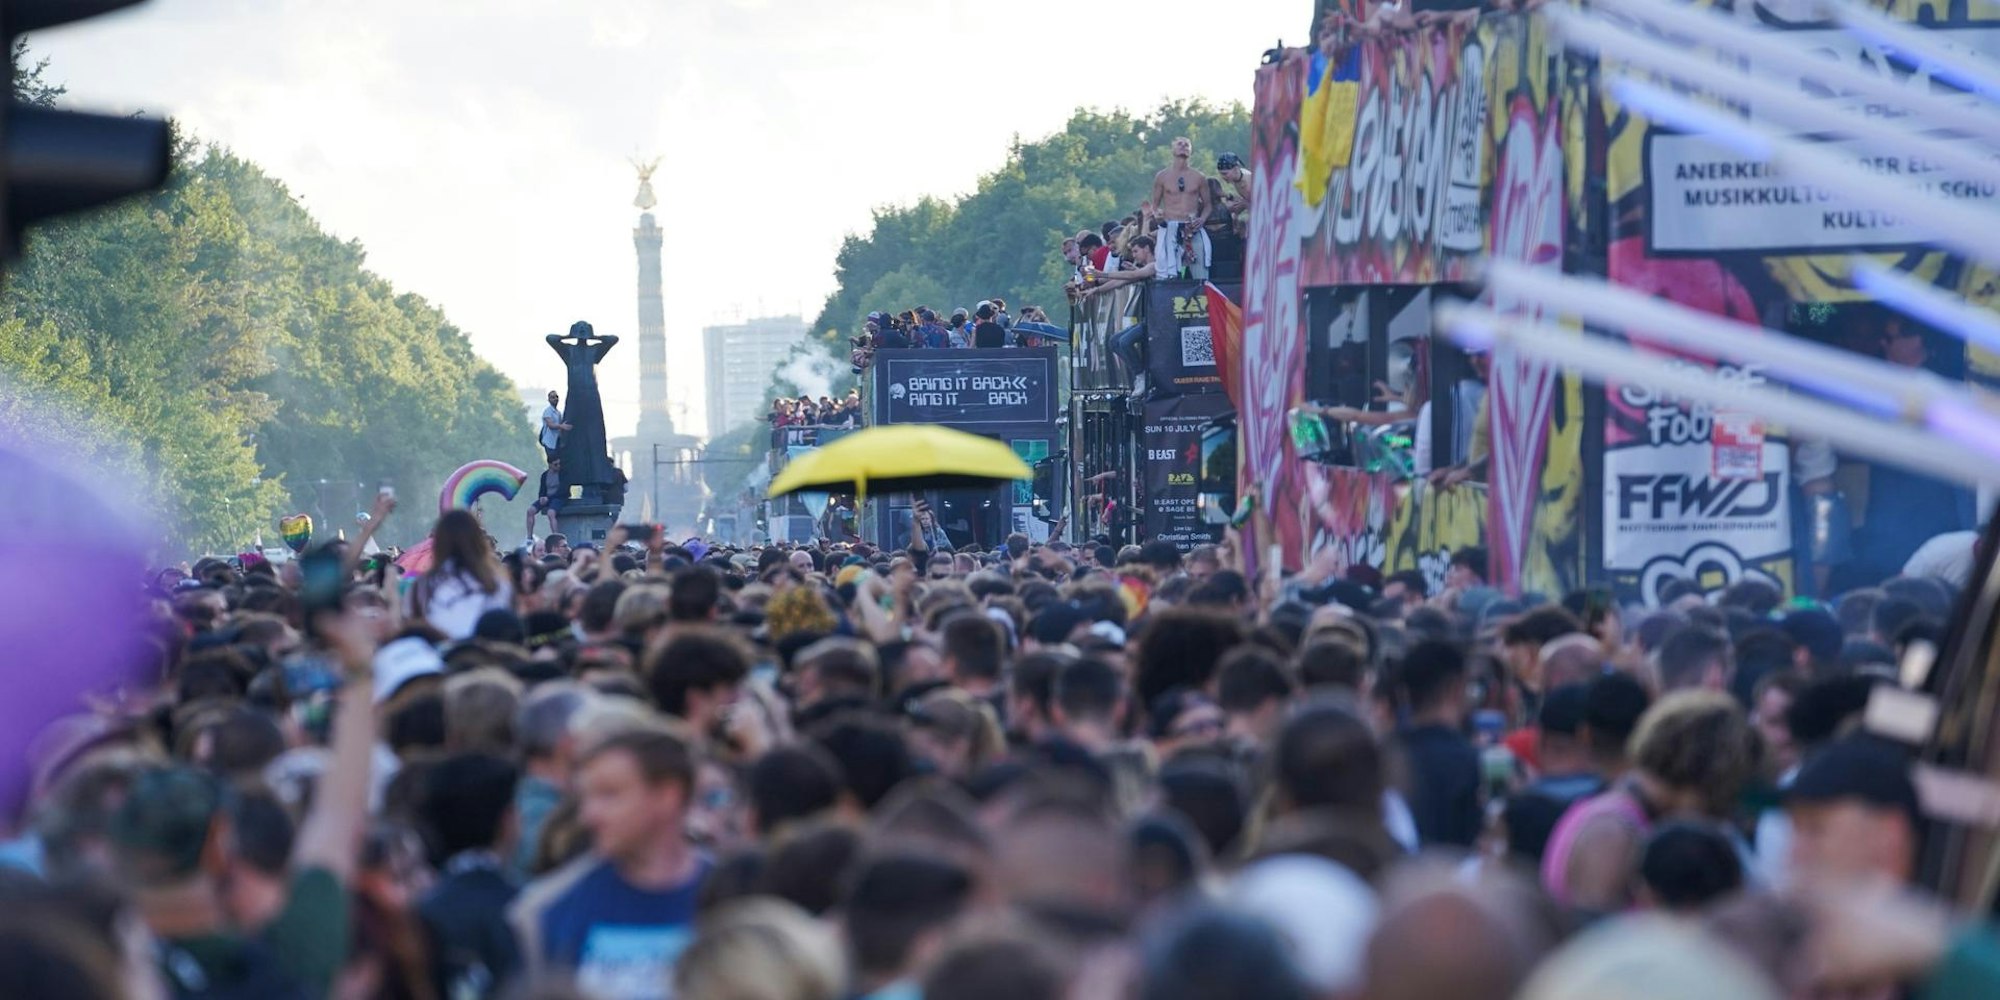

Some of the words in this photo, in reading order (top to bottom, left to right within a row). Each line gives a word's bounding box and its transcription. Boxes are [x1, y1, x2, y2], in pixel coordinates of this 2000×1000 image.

[1940, 181, 1996, 199] SCHU
[908, 377, 953, 391] BRING
[955, 376, 969, 390] IT
[945, 392, 959, 405] IT
[988, 391, 1028, 405] BACK
[1144, 425, 1162, 433] SUN
[1174, 424, 1196, 432] JULY
[1157, 533, 1189, 541] Christian
[1190, 533, 1211, 541] Smith
